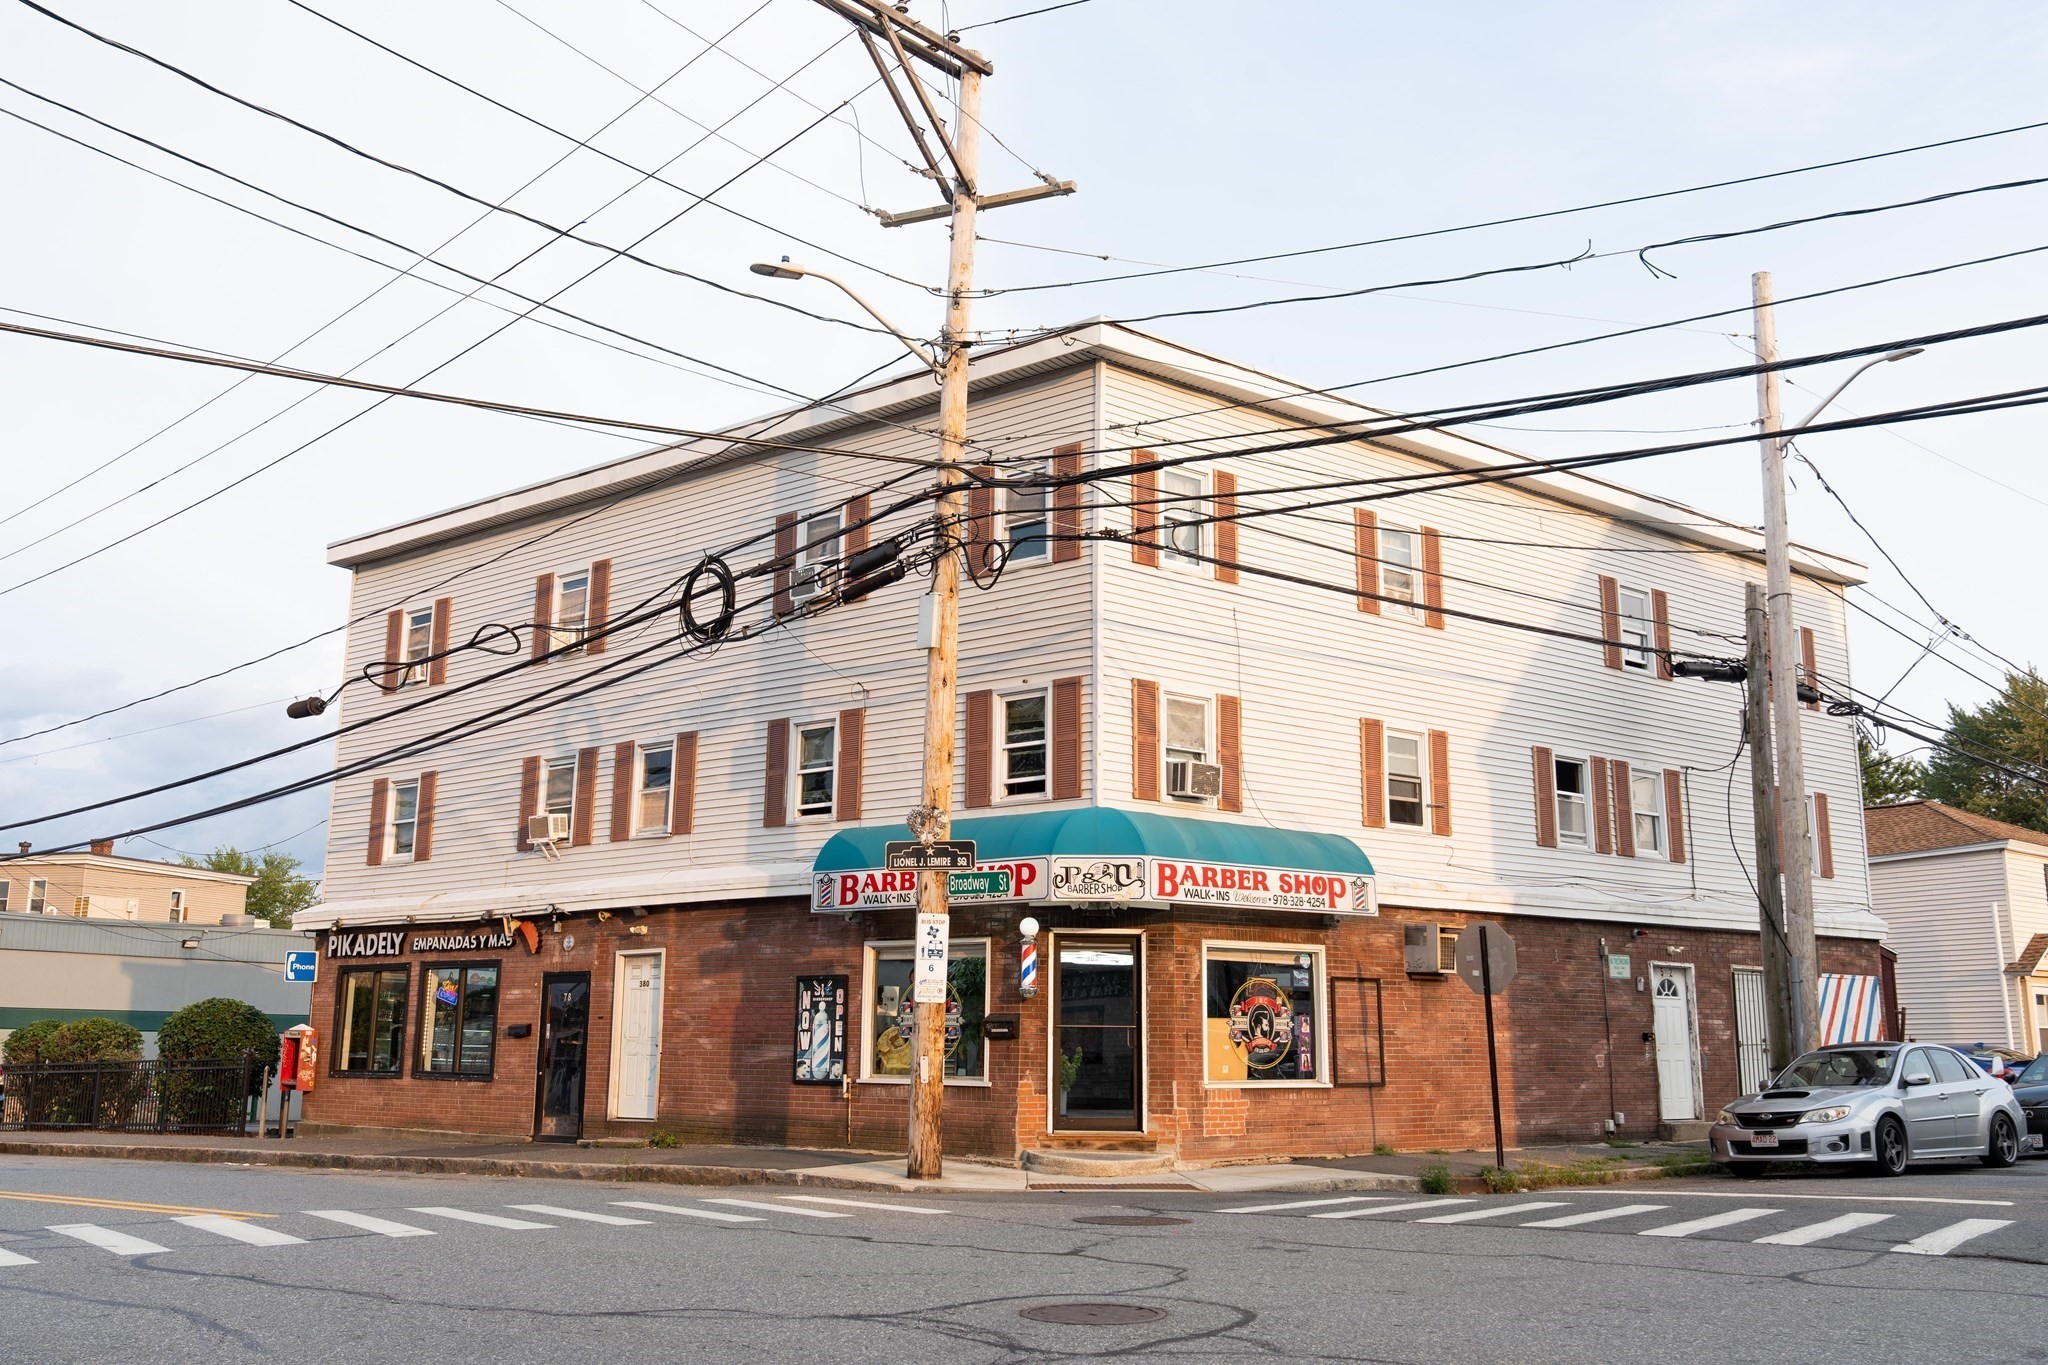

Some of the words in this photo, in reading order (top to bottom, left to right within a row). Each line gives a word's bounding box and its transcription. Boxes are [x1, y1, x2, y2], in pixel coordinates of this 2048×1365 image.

[894, 857, 918, 867] LIONEL
[919, 857, 926, 867] J.
[927, 857, 951, 867] LEMIRE
[957, 856, 968, 867] SQ
[839, 872, 917, 906] BARB
[950, 875, 989, 893] Broadway
[998, 874, 1008, 891] St
[1067, 883, 1123, 895] BARBERSHOP
[1157, 863, 1270, 897] BARBER
[1279, 873, 1347, 909] SHOP
[863, 893, 911, 905] WALK-INS
[1183, 888, 1230, 901] WALK-INS
[1233, 889, 1268, 905] Welcome
[327, 932, 405, 958] PIKADELY
[413, 935, 477, 951] EMPANADAS
[479, 935, 487, 949] Y
[488, 933, 513, 948] MAS
[292, 963, 315, 971] Phone
[928, 964, 935, 972] 6
[639, 980, 650, 988] 380
[563, 993, 572, 1002] 78
[800, 990, 811, 1051] NOW
[834, 988, 844, 1052] OPEN
